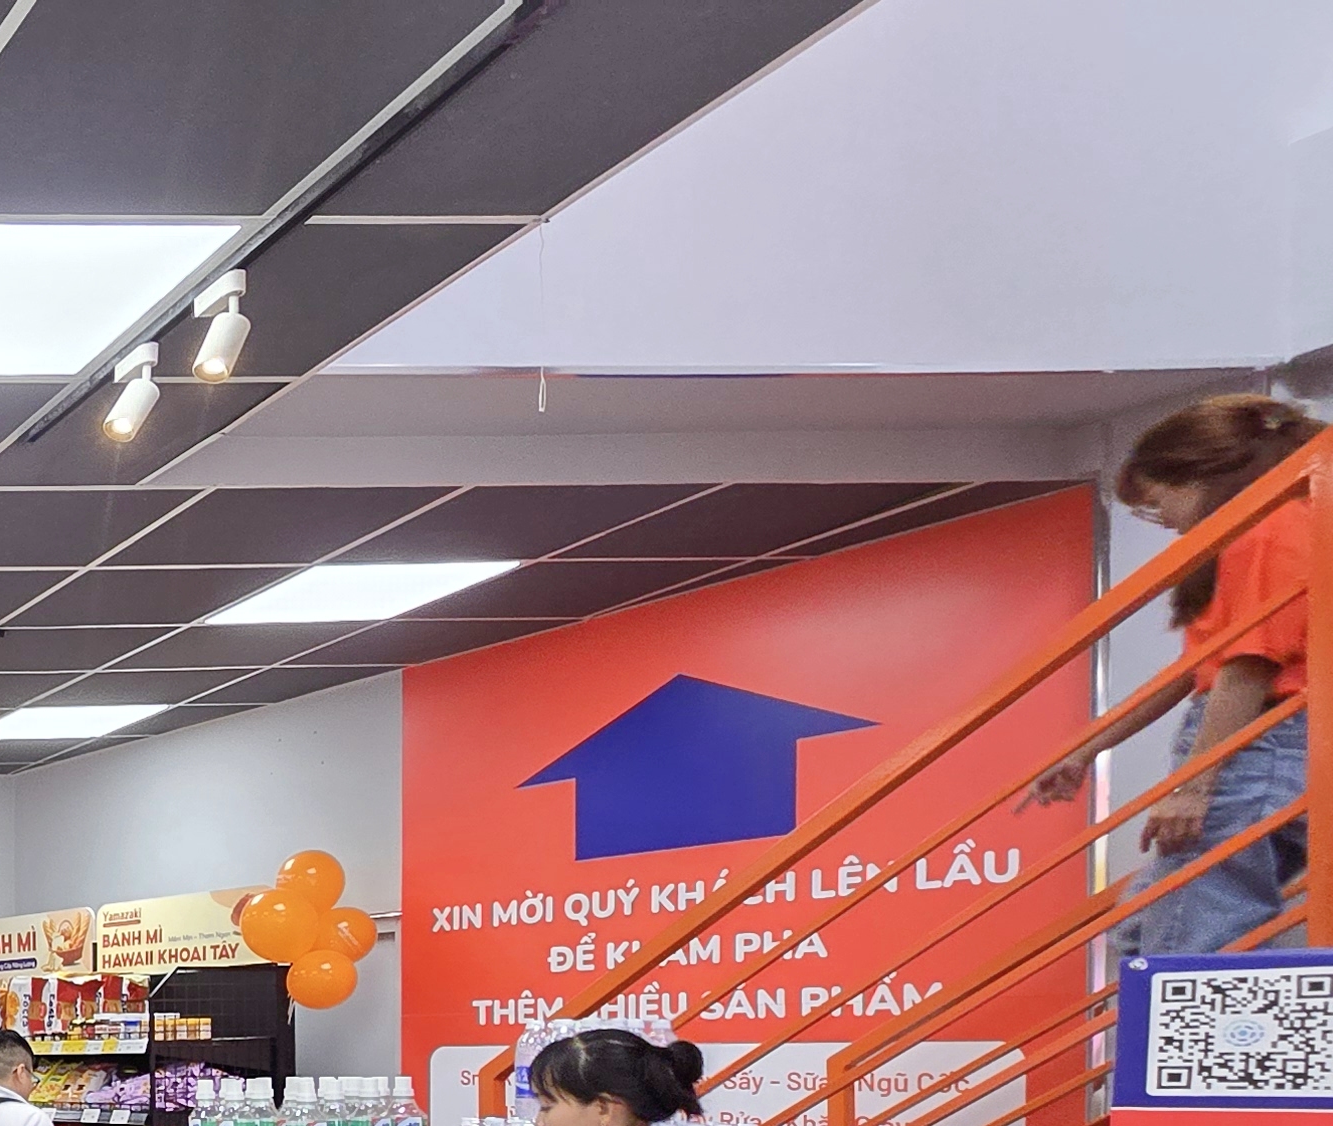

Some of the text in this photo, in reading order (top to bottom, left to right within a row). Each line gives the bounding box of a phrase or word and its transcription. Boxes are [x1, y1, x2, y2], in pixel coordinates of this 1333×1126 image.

[432, 902, 482, 932] XIN
[492, 889, 554, 928] MỜI
[564, 878, 639, 926] QUÝ
[915, 838, 1020, 889] LẦU
[102, 908, 142, 922] Yamazaki
[17, 925, 37, 952] MÌ
[102, 924, 162, 949] BÁNH MÌ
[102, 940, 240, 970] HAWAII KHOAI TÂY
[547, 932, 596, 972] ĐỂ
[595, 981, 688, 1022] HIỀU
[723, 1069, 909, 1097] Sấy Sữa Ngũ
